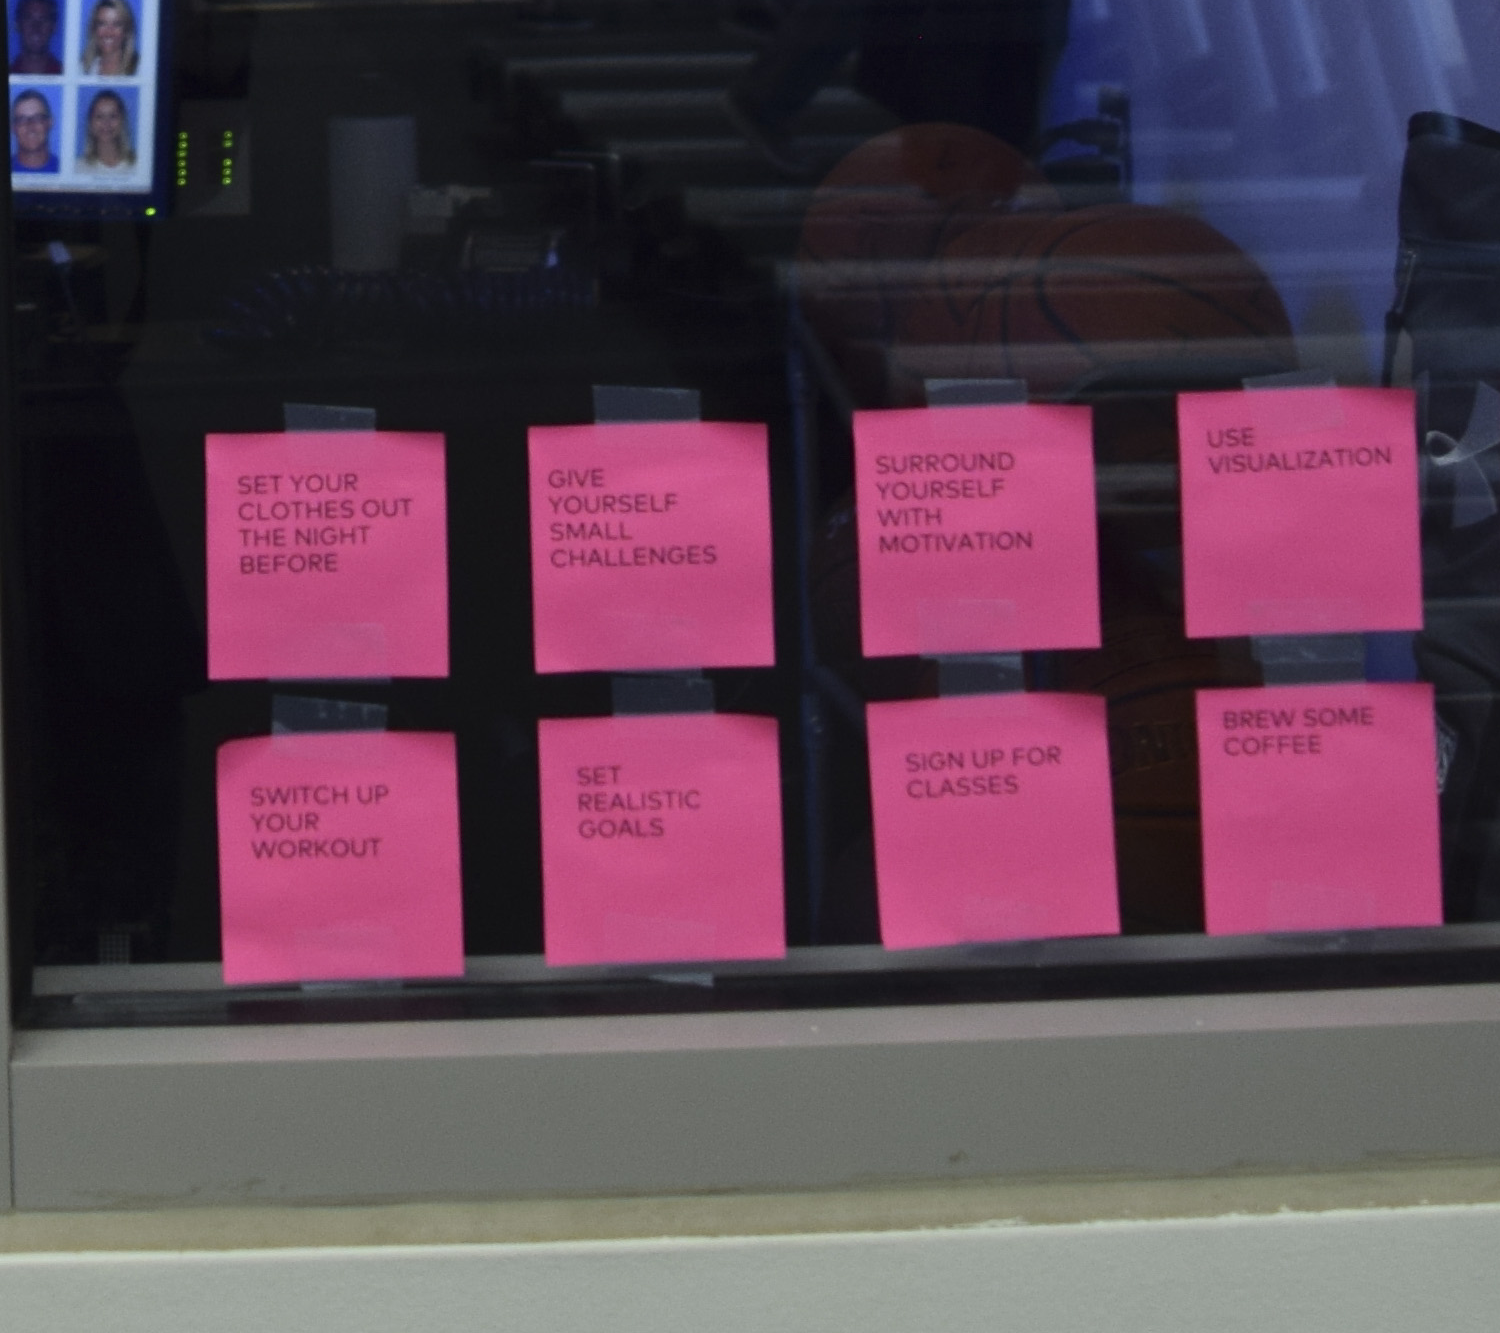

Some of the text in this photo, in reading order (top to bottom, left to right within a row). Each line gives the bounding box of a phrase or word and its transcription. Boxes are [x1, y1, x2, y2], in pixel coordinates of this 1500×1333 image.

[547, 468, 604, 489] GIVE
[547, 492, 678, 516] YOURSELF
[549, 521, 633, 542] SMALL
[549, 544, 718, 569] CHALLENGES
[905, 745, 1062, 773] SIGN UP FOR
[576, 764, 622, 787] SET
[905, 773, 1020, 800] CLASSES
[250, 784, 390, 807] SWITCH UP
[577, 789, 701, 813] REALISTIC
[250, 812, 320, 833] YOUR
[577, 817, 665, 840] GOALS
[250, 837, 382, 860] WORKOUT
